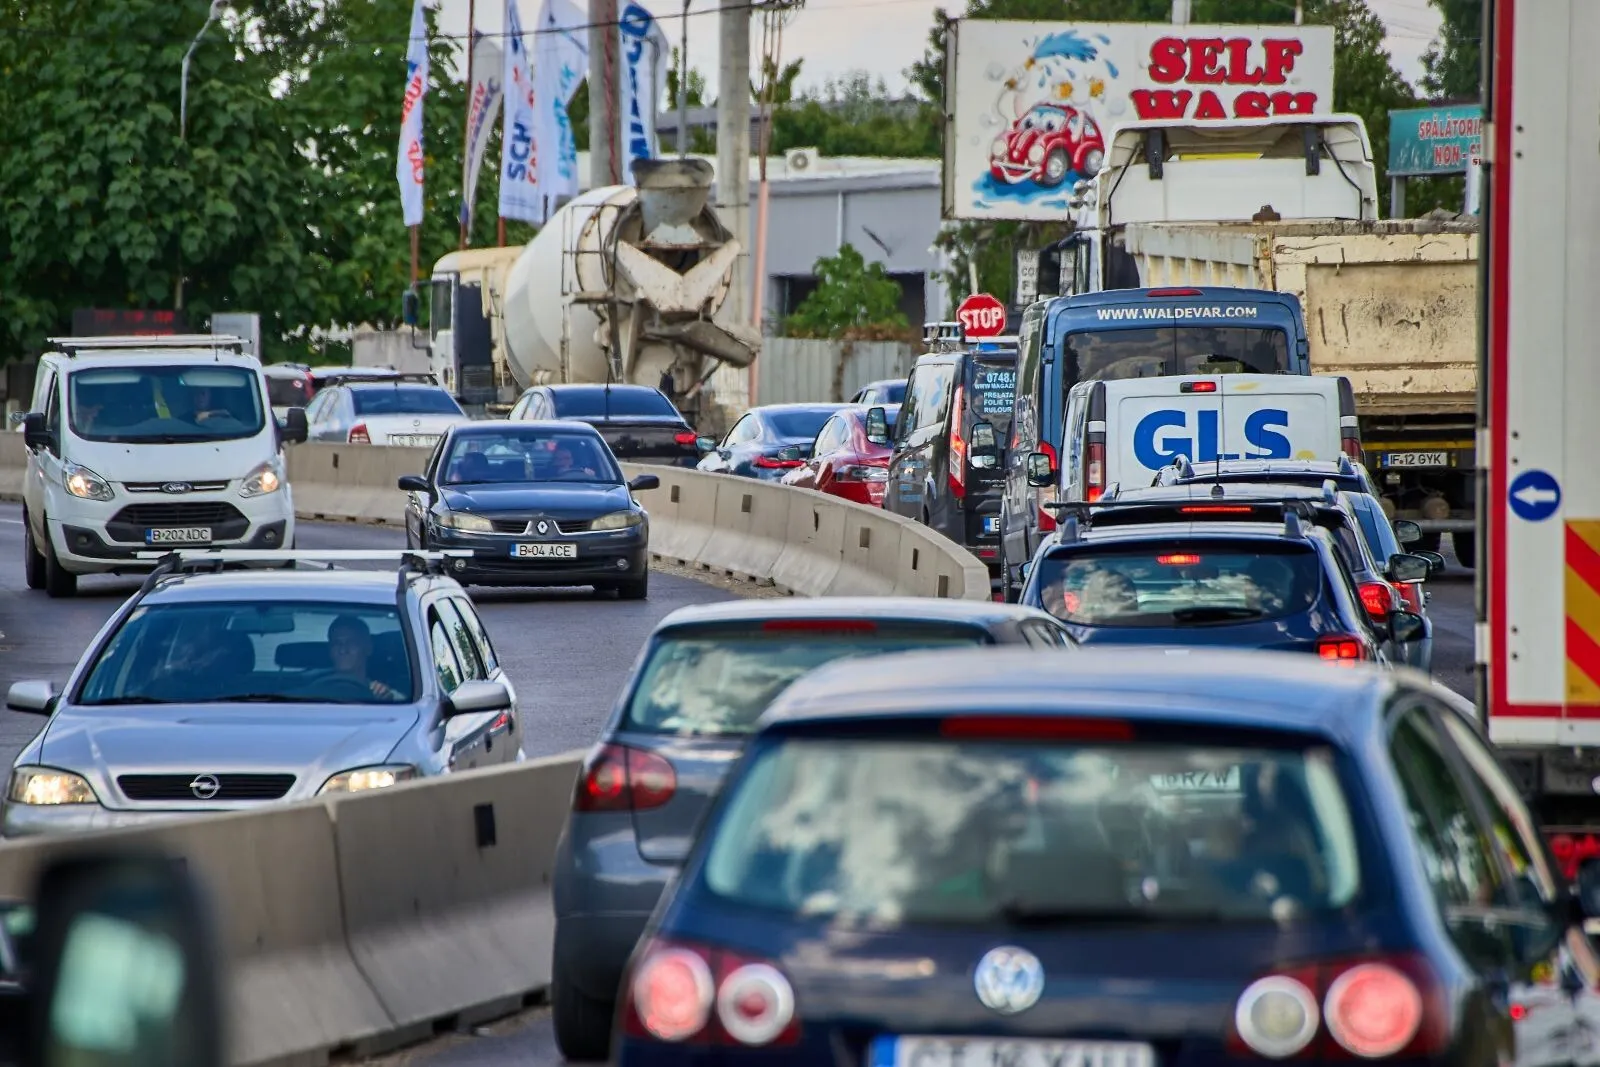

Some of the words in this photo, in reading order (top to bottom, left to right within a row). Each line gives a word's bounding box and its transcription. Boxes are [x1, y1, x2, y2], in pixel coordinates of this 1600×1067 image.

[1148, 35, 1303, 84] SELF
[1130, 89, 1317, 120] WASH
[959, 307, 1003, 330] STOP
[1096, 306, 1258, 321] WWW.WALDEVAR.COM
[1133, 408, 1291, 471] GLS
